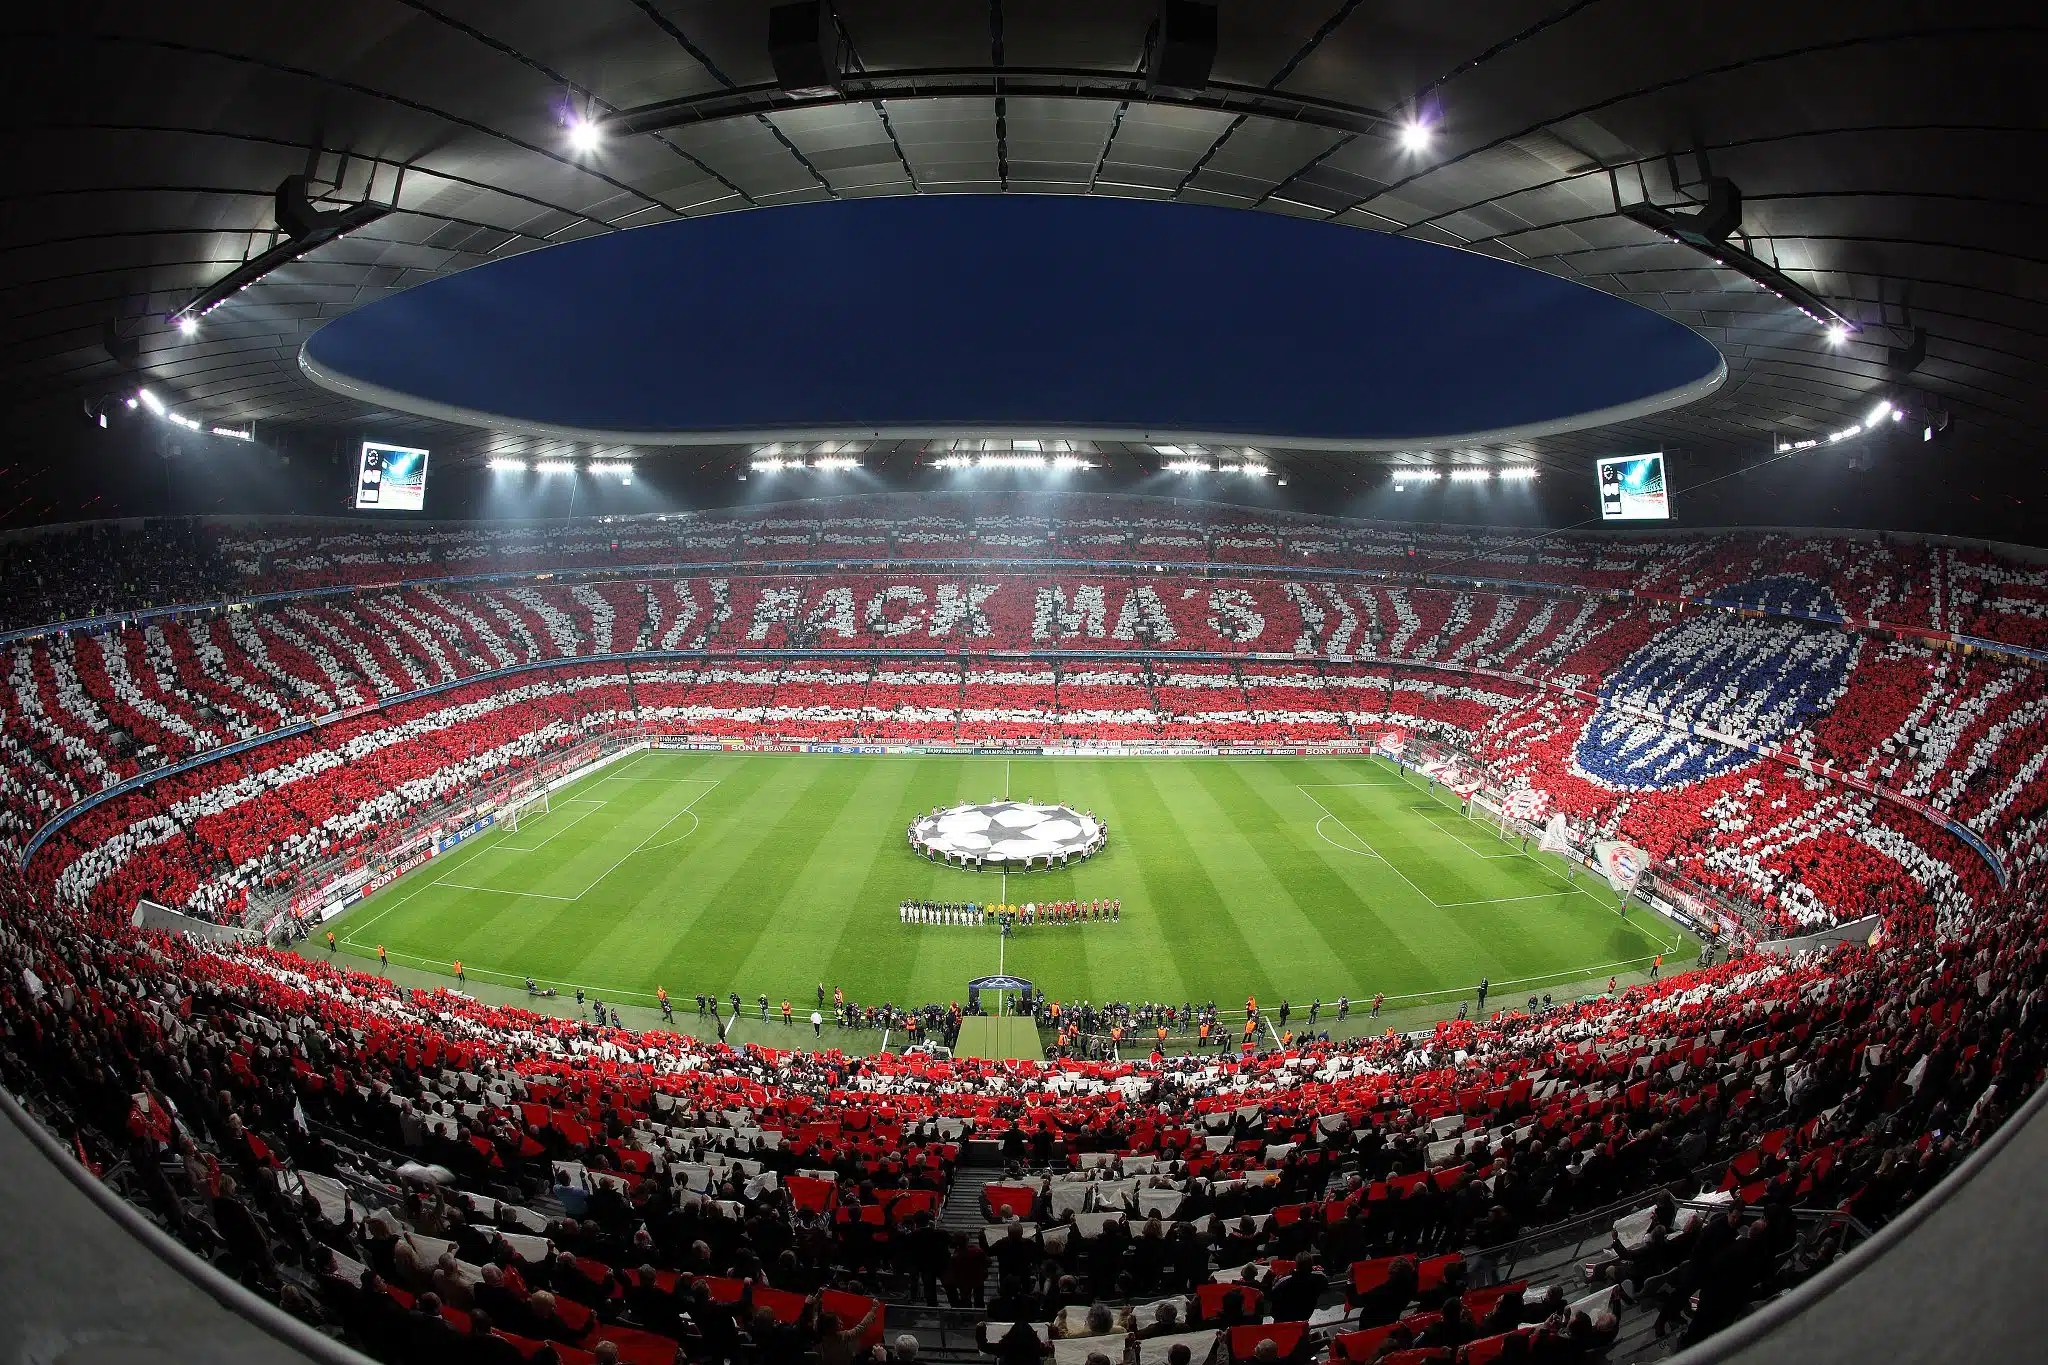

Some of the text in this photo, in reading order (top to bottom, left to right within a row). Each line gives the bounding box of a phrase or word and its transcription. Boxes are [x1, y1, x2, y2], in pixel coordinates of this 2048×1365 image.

[812, 746, 834, 754] Ford
[460, 824, 476, 841] Ford
[370, 869, 398, 892] SONY
[400, 854, 426, 875] BRAVIA
